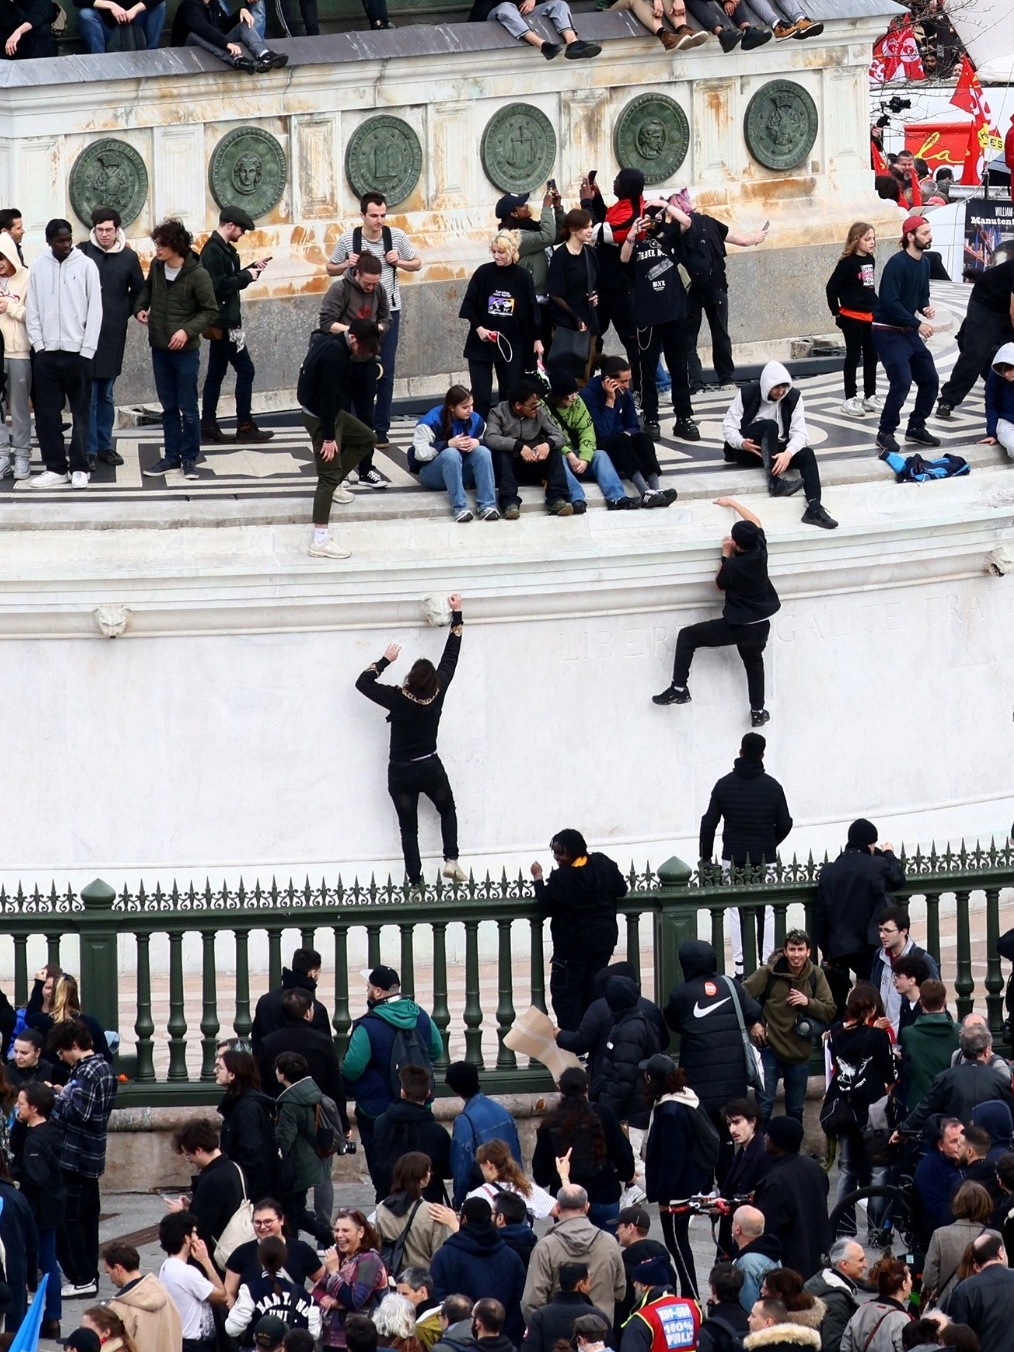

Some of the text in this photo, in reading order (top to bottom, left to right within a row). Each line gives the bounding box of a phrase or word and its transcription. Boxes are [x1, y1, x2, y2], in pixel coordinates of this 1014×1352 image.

[914, 131, 965, 164] la
[995, 206, 1013, 217] WILLIAM
[256, 1292, 310, 1317] HANYNG
[664, 1321, 694, 1334] 100%
[666, 1330, 694, 1346] PUBLIC
